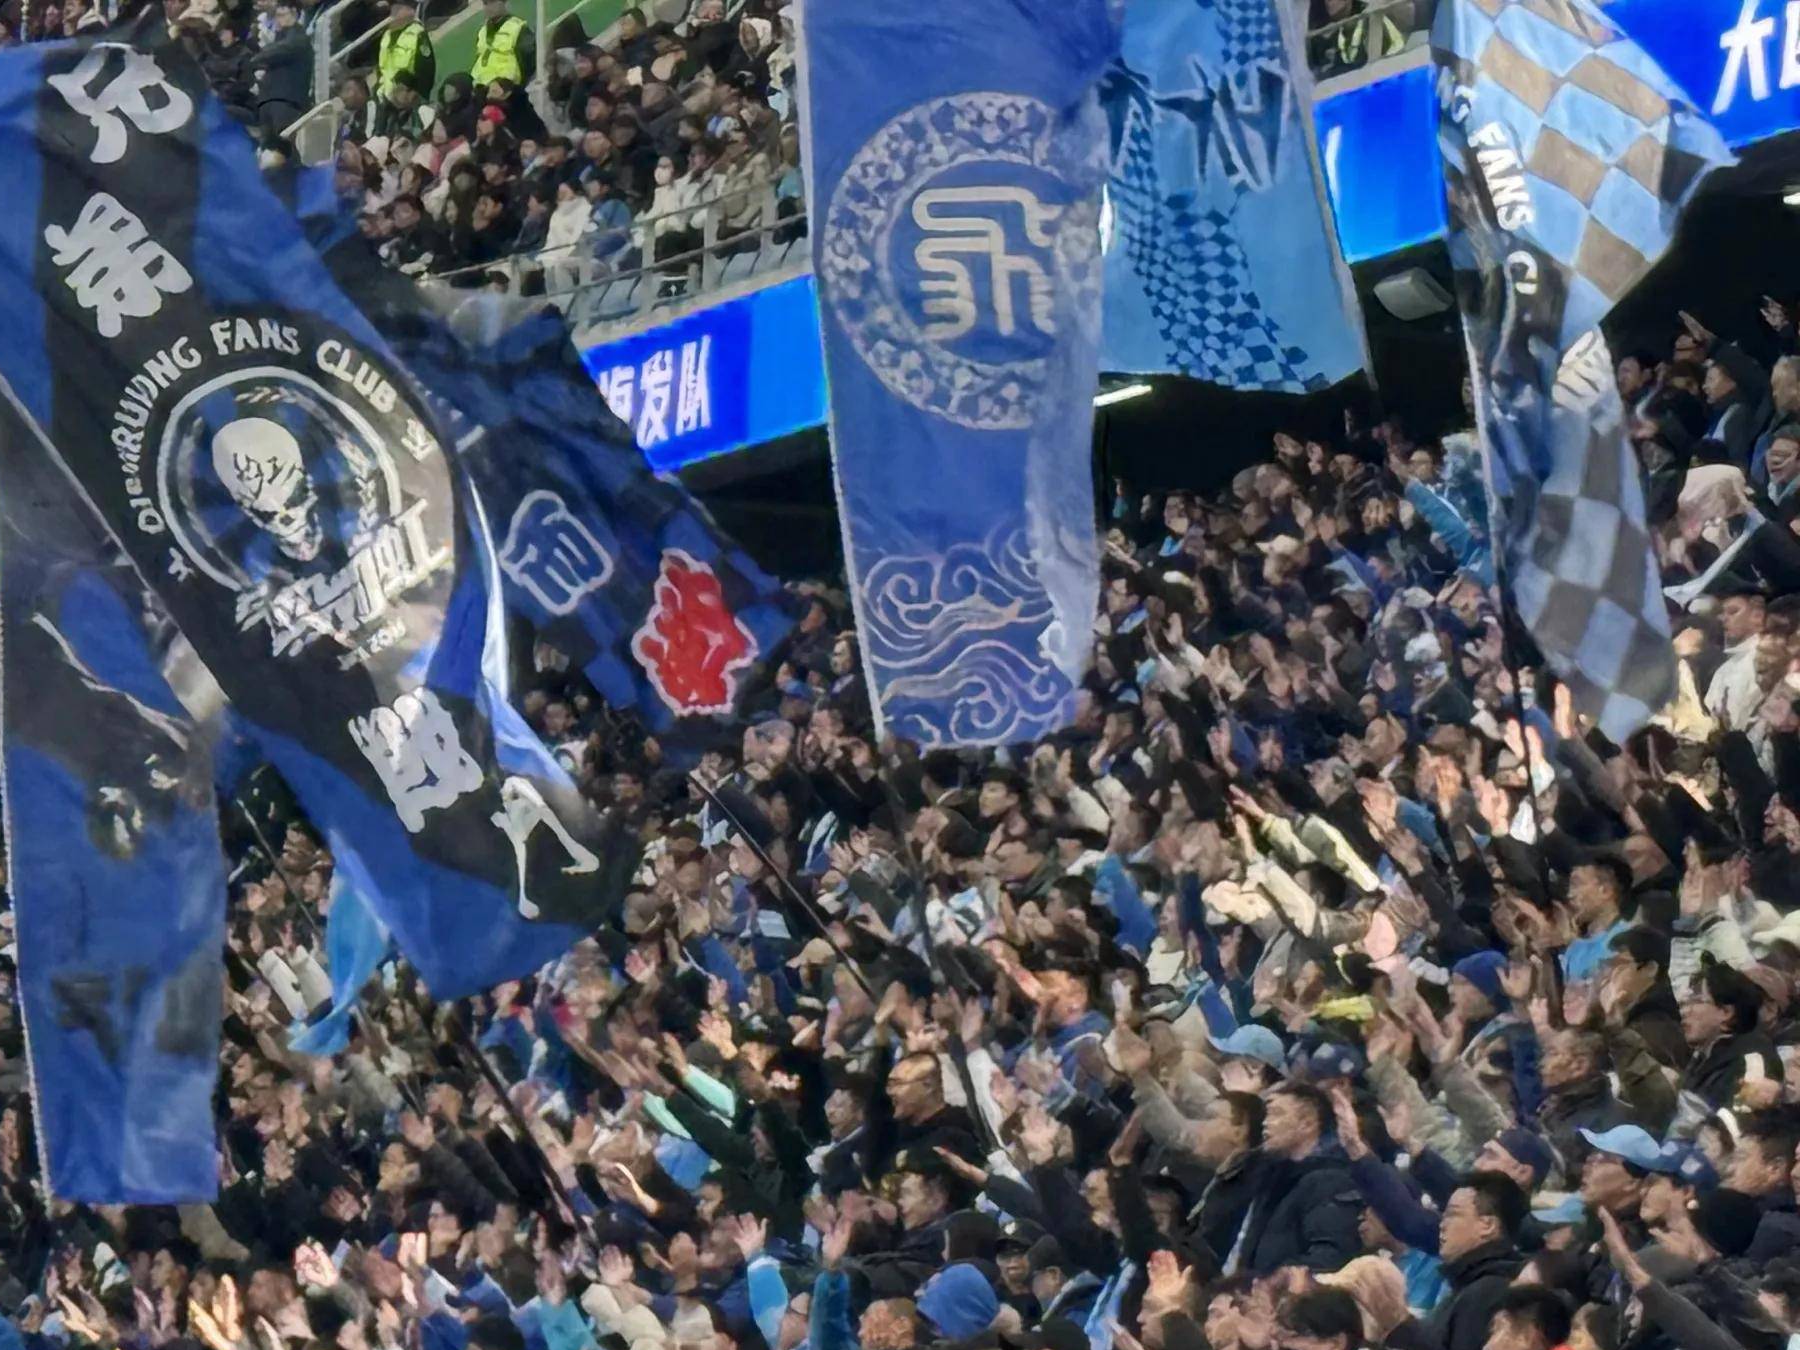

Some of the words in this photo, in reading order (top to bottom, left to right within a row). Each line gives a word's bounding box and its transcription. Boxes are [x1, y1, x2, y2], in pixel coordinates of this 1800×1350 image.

[1467, 120, 1535, 232] FANS
[209, 318, 301, 355] FANS
[315, 339, 398, 413] CLUB
